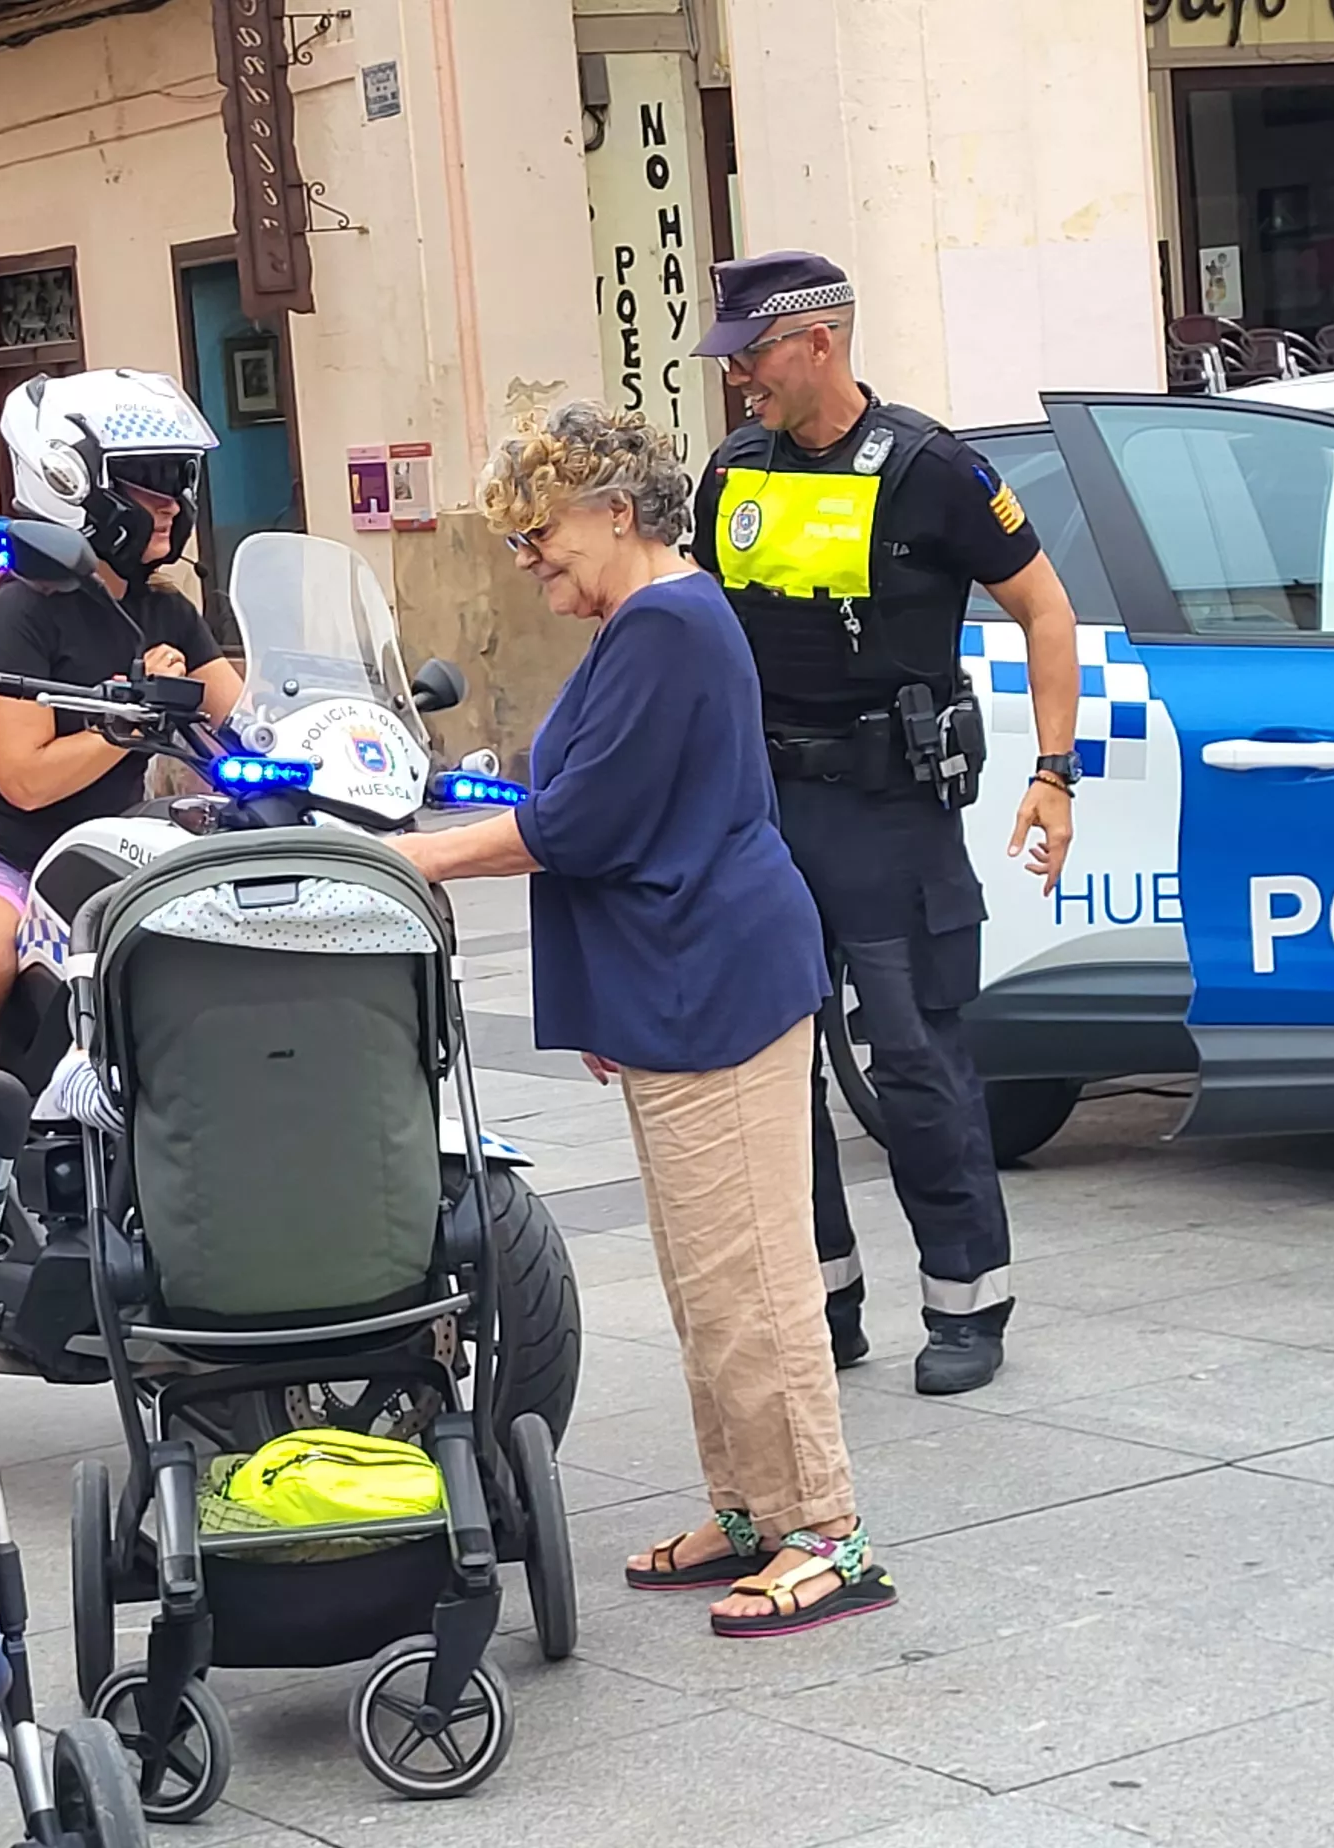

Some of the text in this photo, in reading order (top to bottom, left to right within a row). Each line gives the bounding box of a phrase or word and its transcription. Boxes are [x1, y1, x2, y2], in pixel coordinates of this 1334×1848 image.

[640, 102, 670, 190] NO
[657, 204, 687, 341] HAY
[301, 705, 359, 752] POLICIA
[347, 783, 414, 803] HUESCA
[119, 837, 159, 867] POLI
